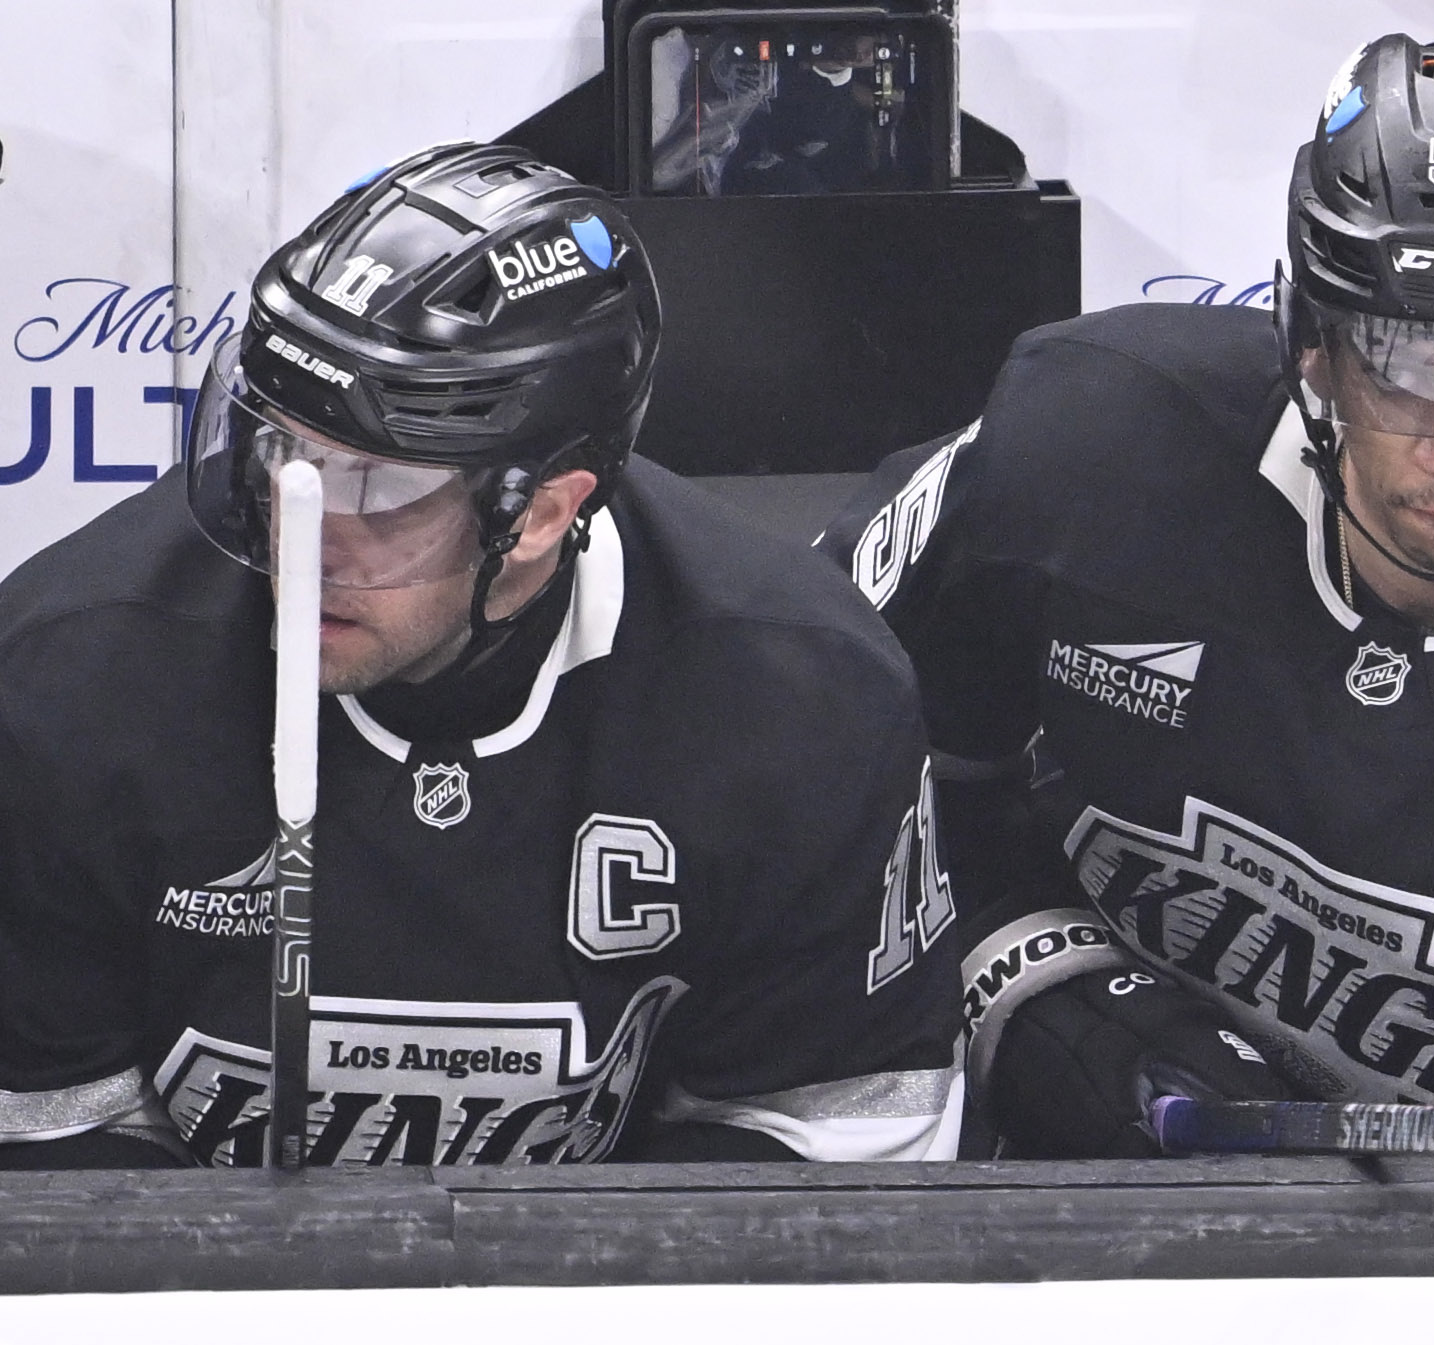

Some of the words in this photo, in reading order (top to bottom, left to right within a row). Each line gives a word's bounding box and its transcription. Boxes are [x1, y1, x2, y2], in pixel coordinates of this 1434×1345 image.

[321, 254, 394, 318] 11
[489, 236, 578, 289] blue
[507, 266, 587, 301] CALIFORNIA
[1047, 659, 1187, 729] INSURANCE
[1050, 639, 1192, 707] MERCURY
[1357, 666, 1397, 687] NHL
[426, 780, 458, 814] NHL
[163, 886, 276, 918] MERCUR
[567, 813, 680, 960] C
[866, 755, 956, 996] 11
[1221, 842, 1275, 887] Los
[1277, 864, 1404, 953] Angeles
[155, 906, 275, 938] INSURANC
[327, 1039, 390, 1070] Los
[395, 1041, 543, 1079] Angeles
